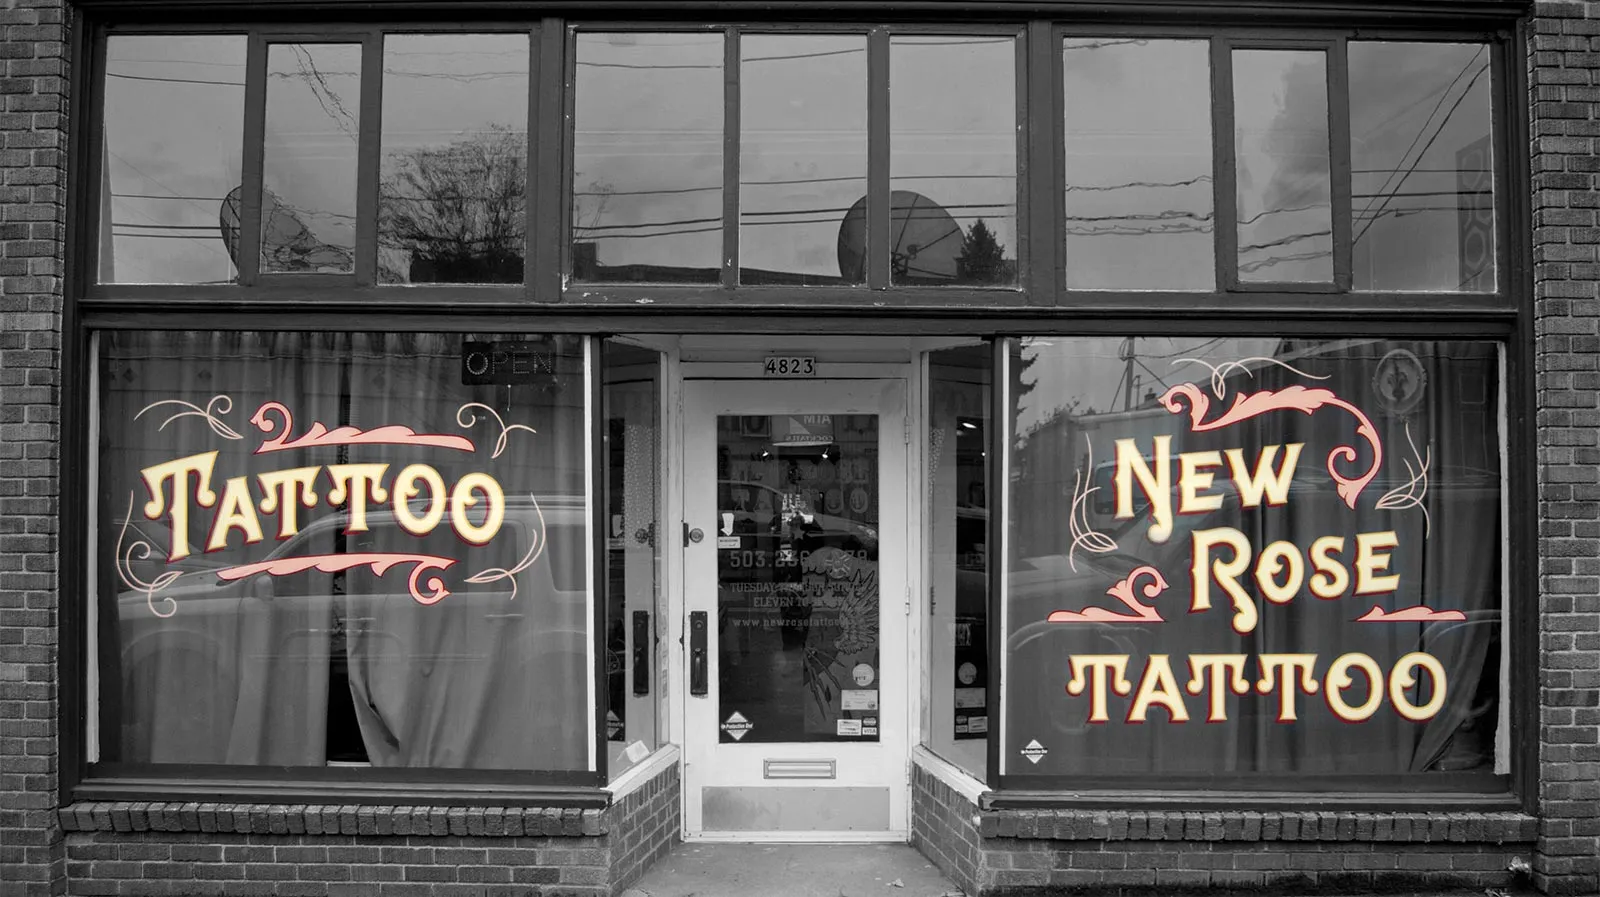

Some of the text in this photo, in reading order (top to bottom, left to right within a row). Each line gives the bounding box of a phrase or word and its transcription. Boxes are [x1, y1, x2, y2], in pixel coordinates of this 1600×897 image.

[466, 351, 552, 376] OPEN
[767, 358, 813, 374] 4823
[139, 449, 506, 565] TATTOO
[1111, 433, 1306, 545] NEW
[730, 582, 776, 593] TUESDAY
[753, 597, 793, 608] ELEVEN
[1187, 526, 1401, 638] ROSE
[1065, 649, 1448, 724] TATTOO
